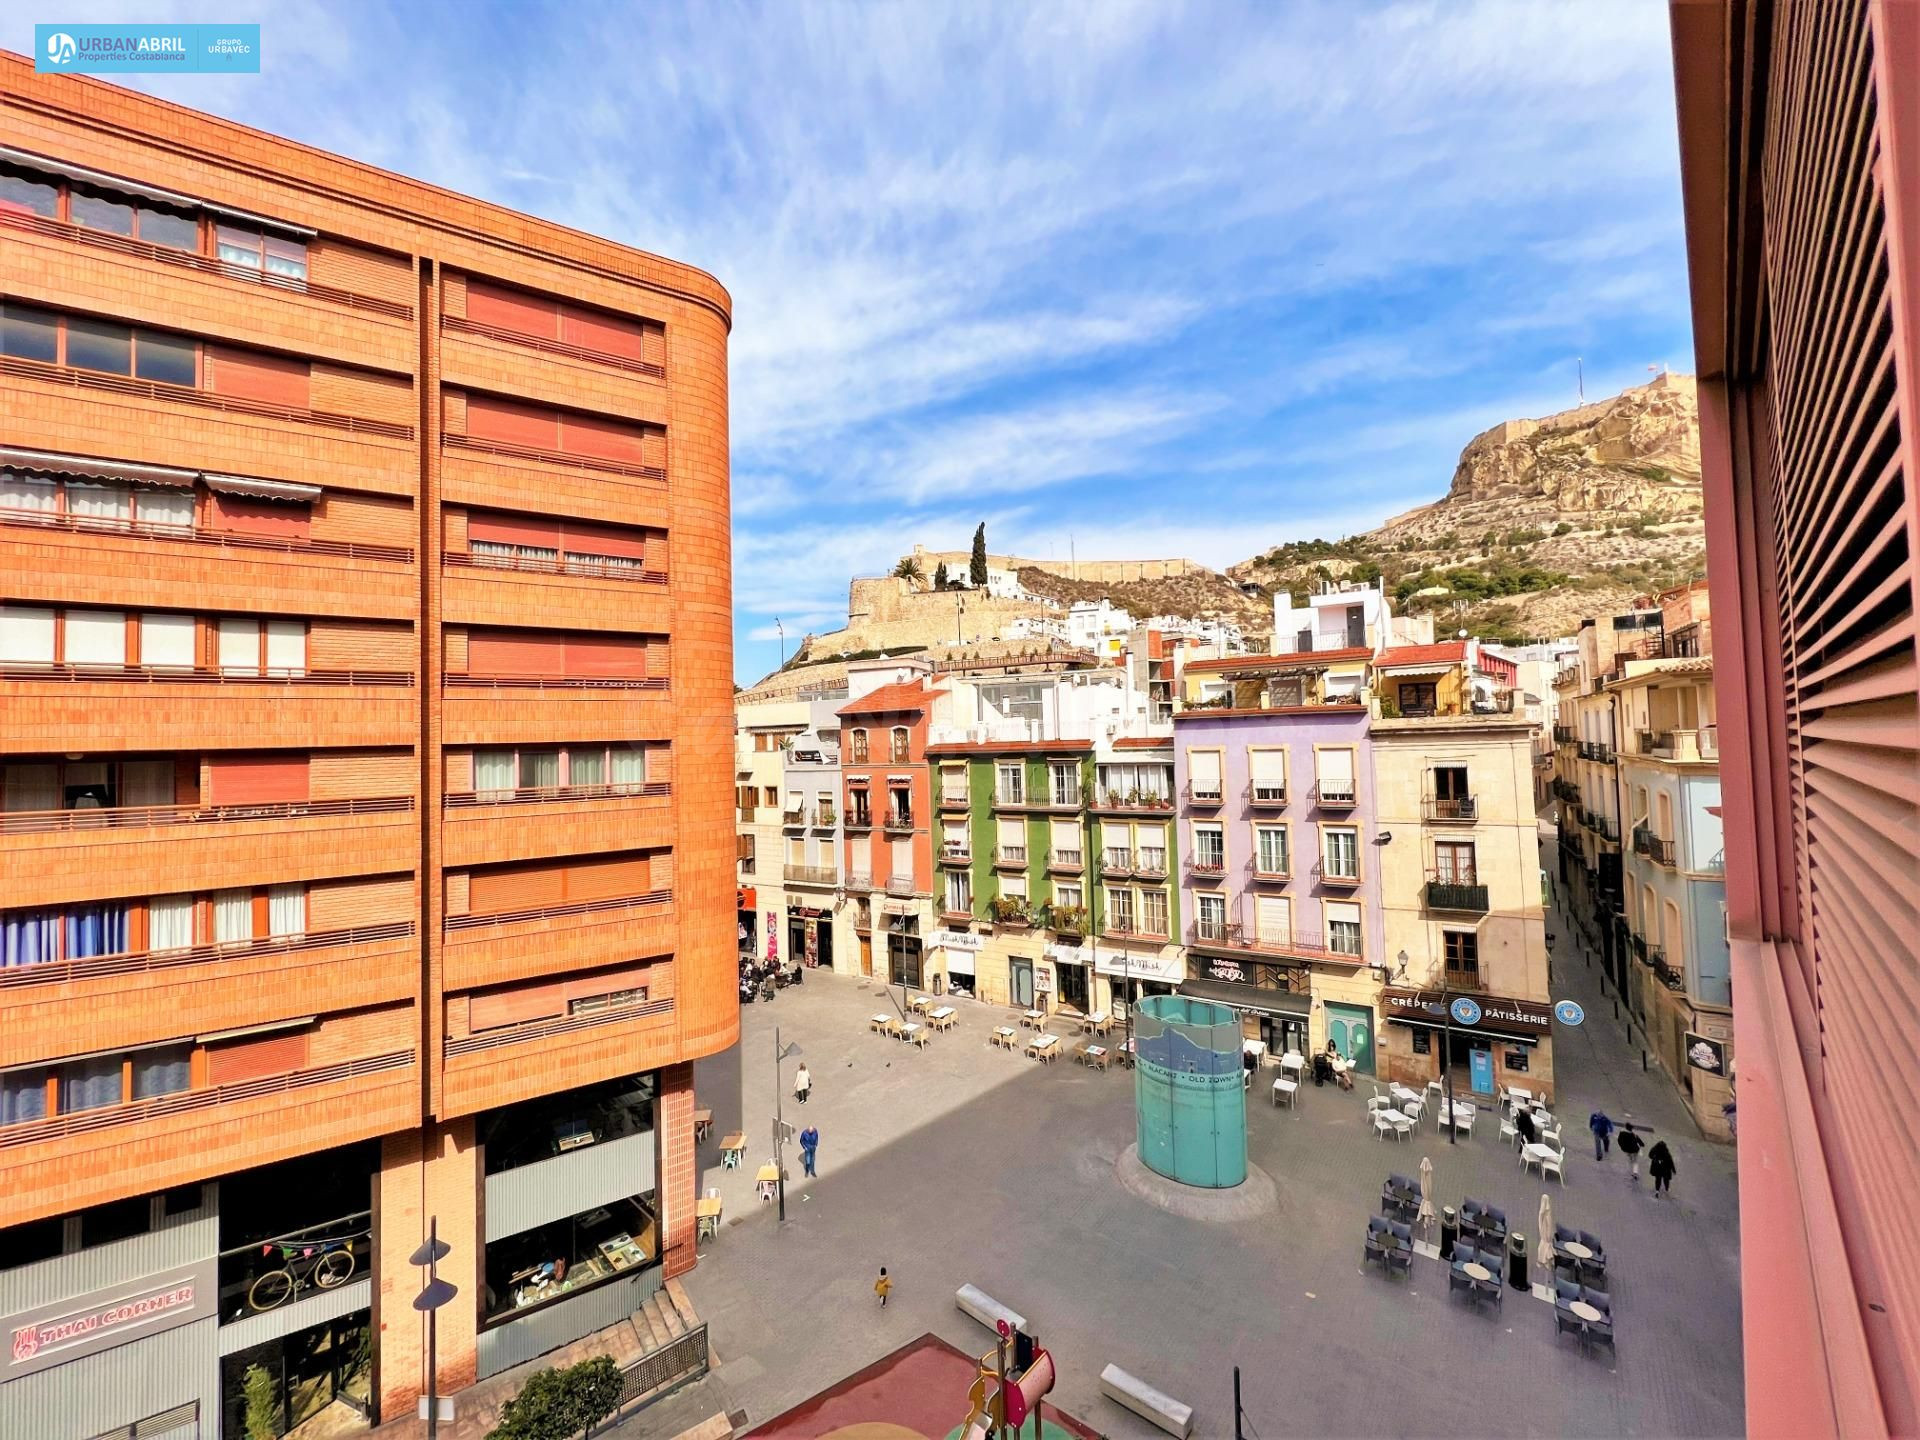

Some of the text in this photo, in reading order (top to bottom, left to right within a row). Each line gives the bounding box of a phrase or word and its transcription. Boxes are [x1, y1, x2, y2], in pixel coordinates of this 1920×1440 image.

[1485, 1008, 1549, 1025] PÂTISSERIE
[1188, 1075, 1206, 1084] OLD
[1208, 1075, 1232, 1084] TOWN
[40, 1286, 194, 1347] THAI CORNER
